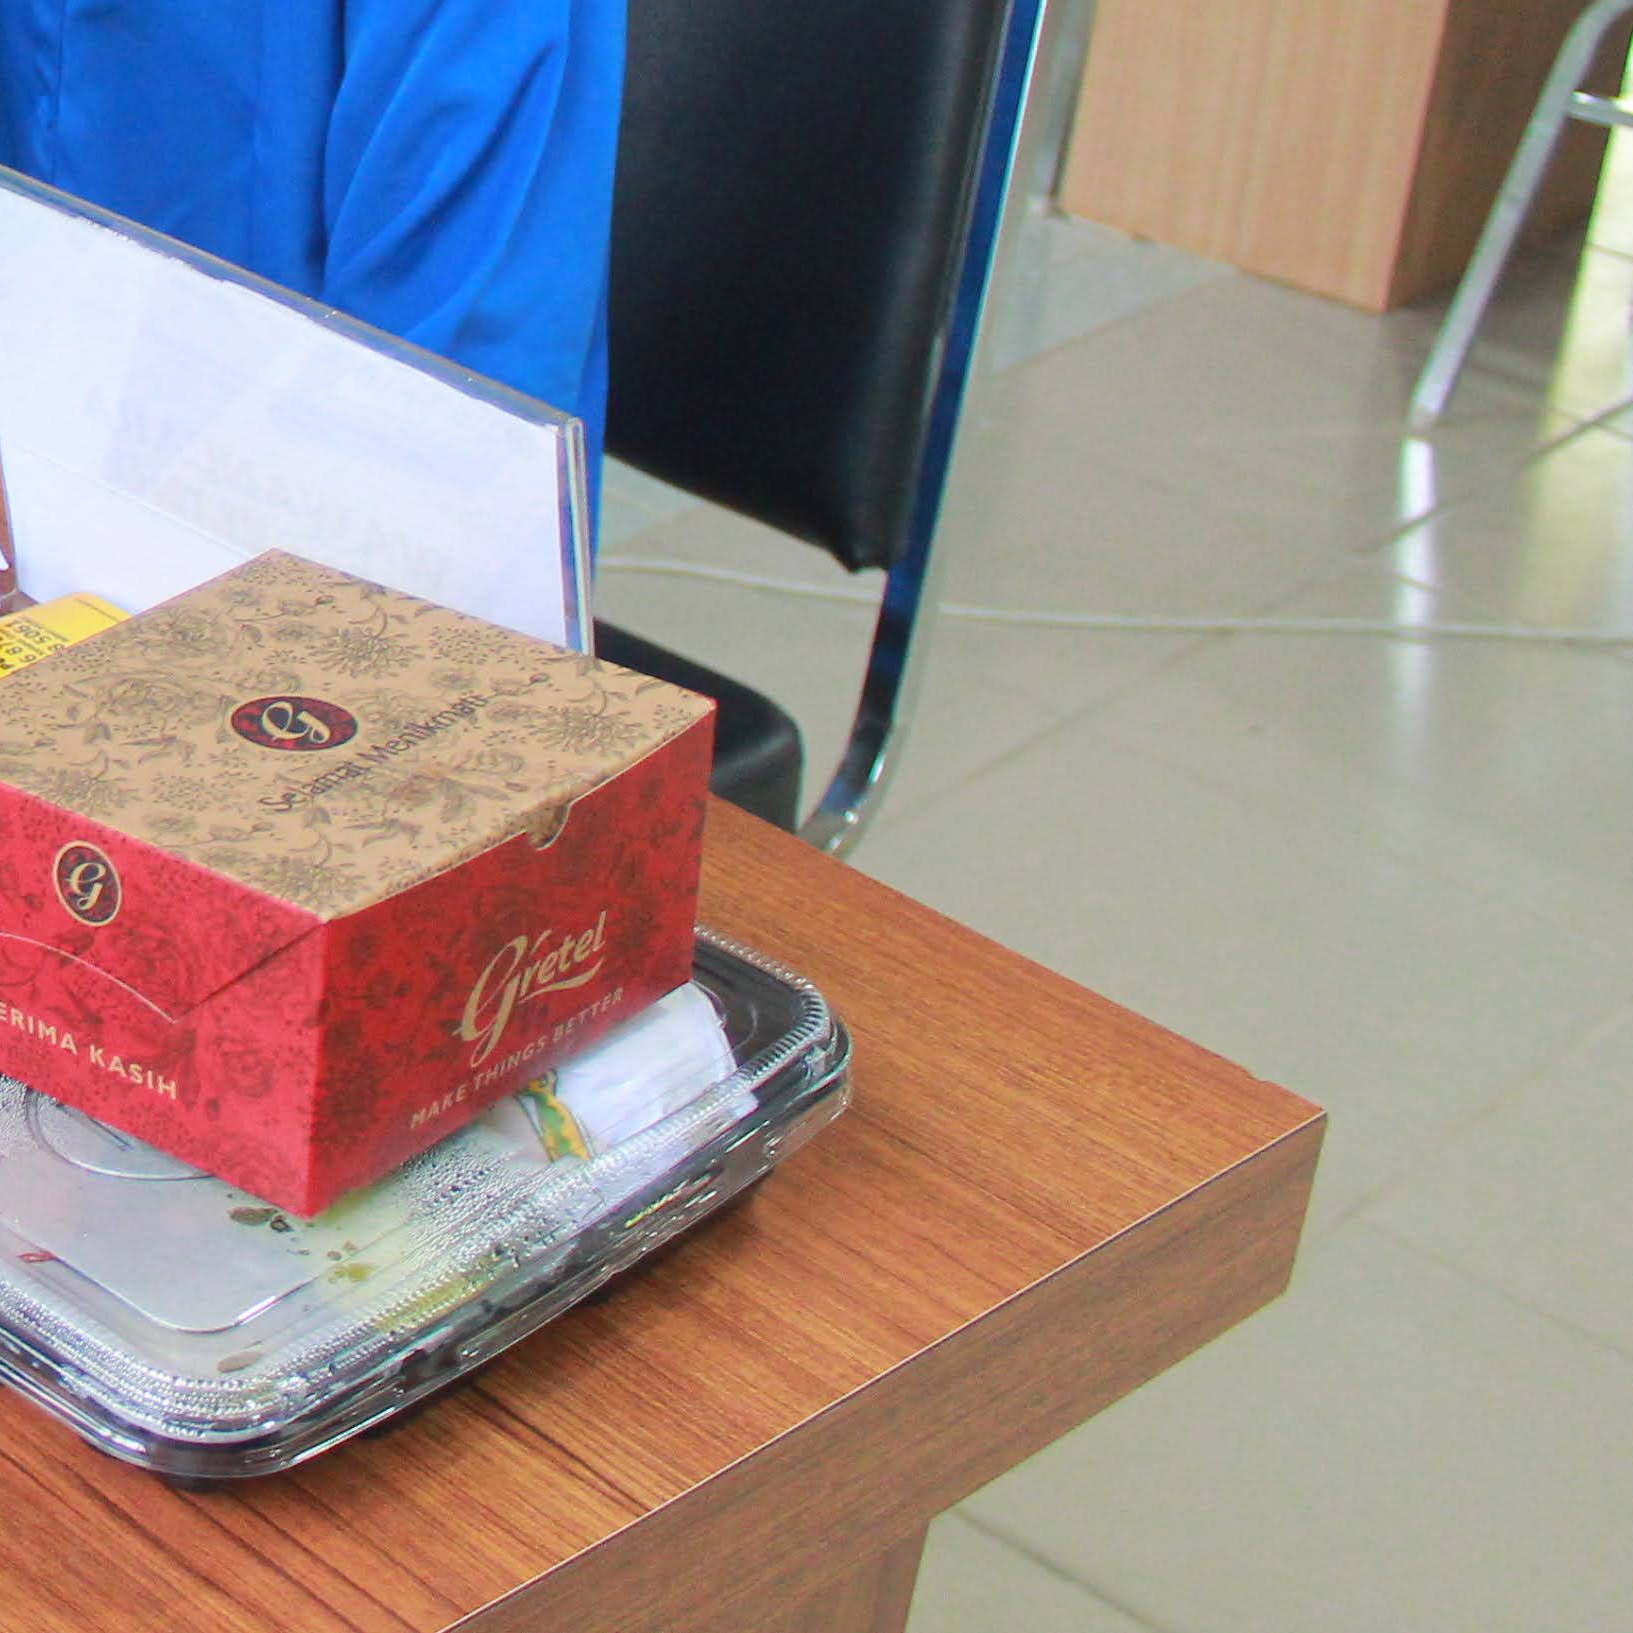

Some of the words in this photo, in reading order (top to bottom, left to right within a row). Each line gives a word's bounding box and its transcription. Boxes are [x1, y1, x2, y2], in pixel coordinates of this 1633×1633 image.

[257, 761, 372, 812] Selamat
[355, 690, 488, 765] Menikmati
[451, 910, 607, 1068] Gretel
[89, 1044, 177, 1100] KASIH
[410, 1084, 468, 1129] MAKE
[473, 1035, 547, 1092] THINGS
[553, 986, 623, 1043] BETTER
